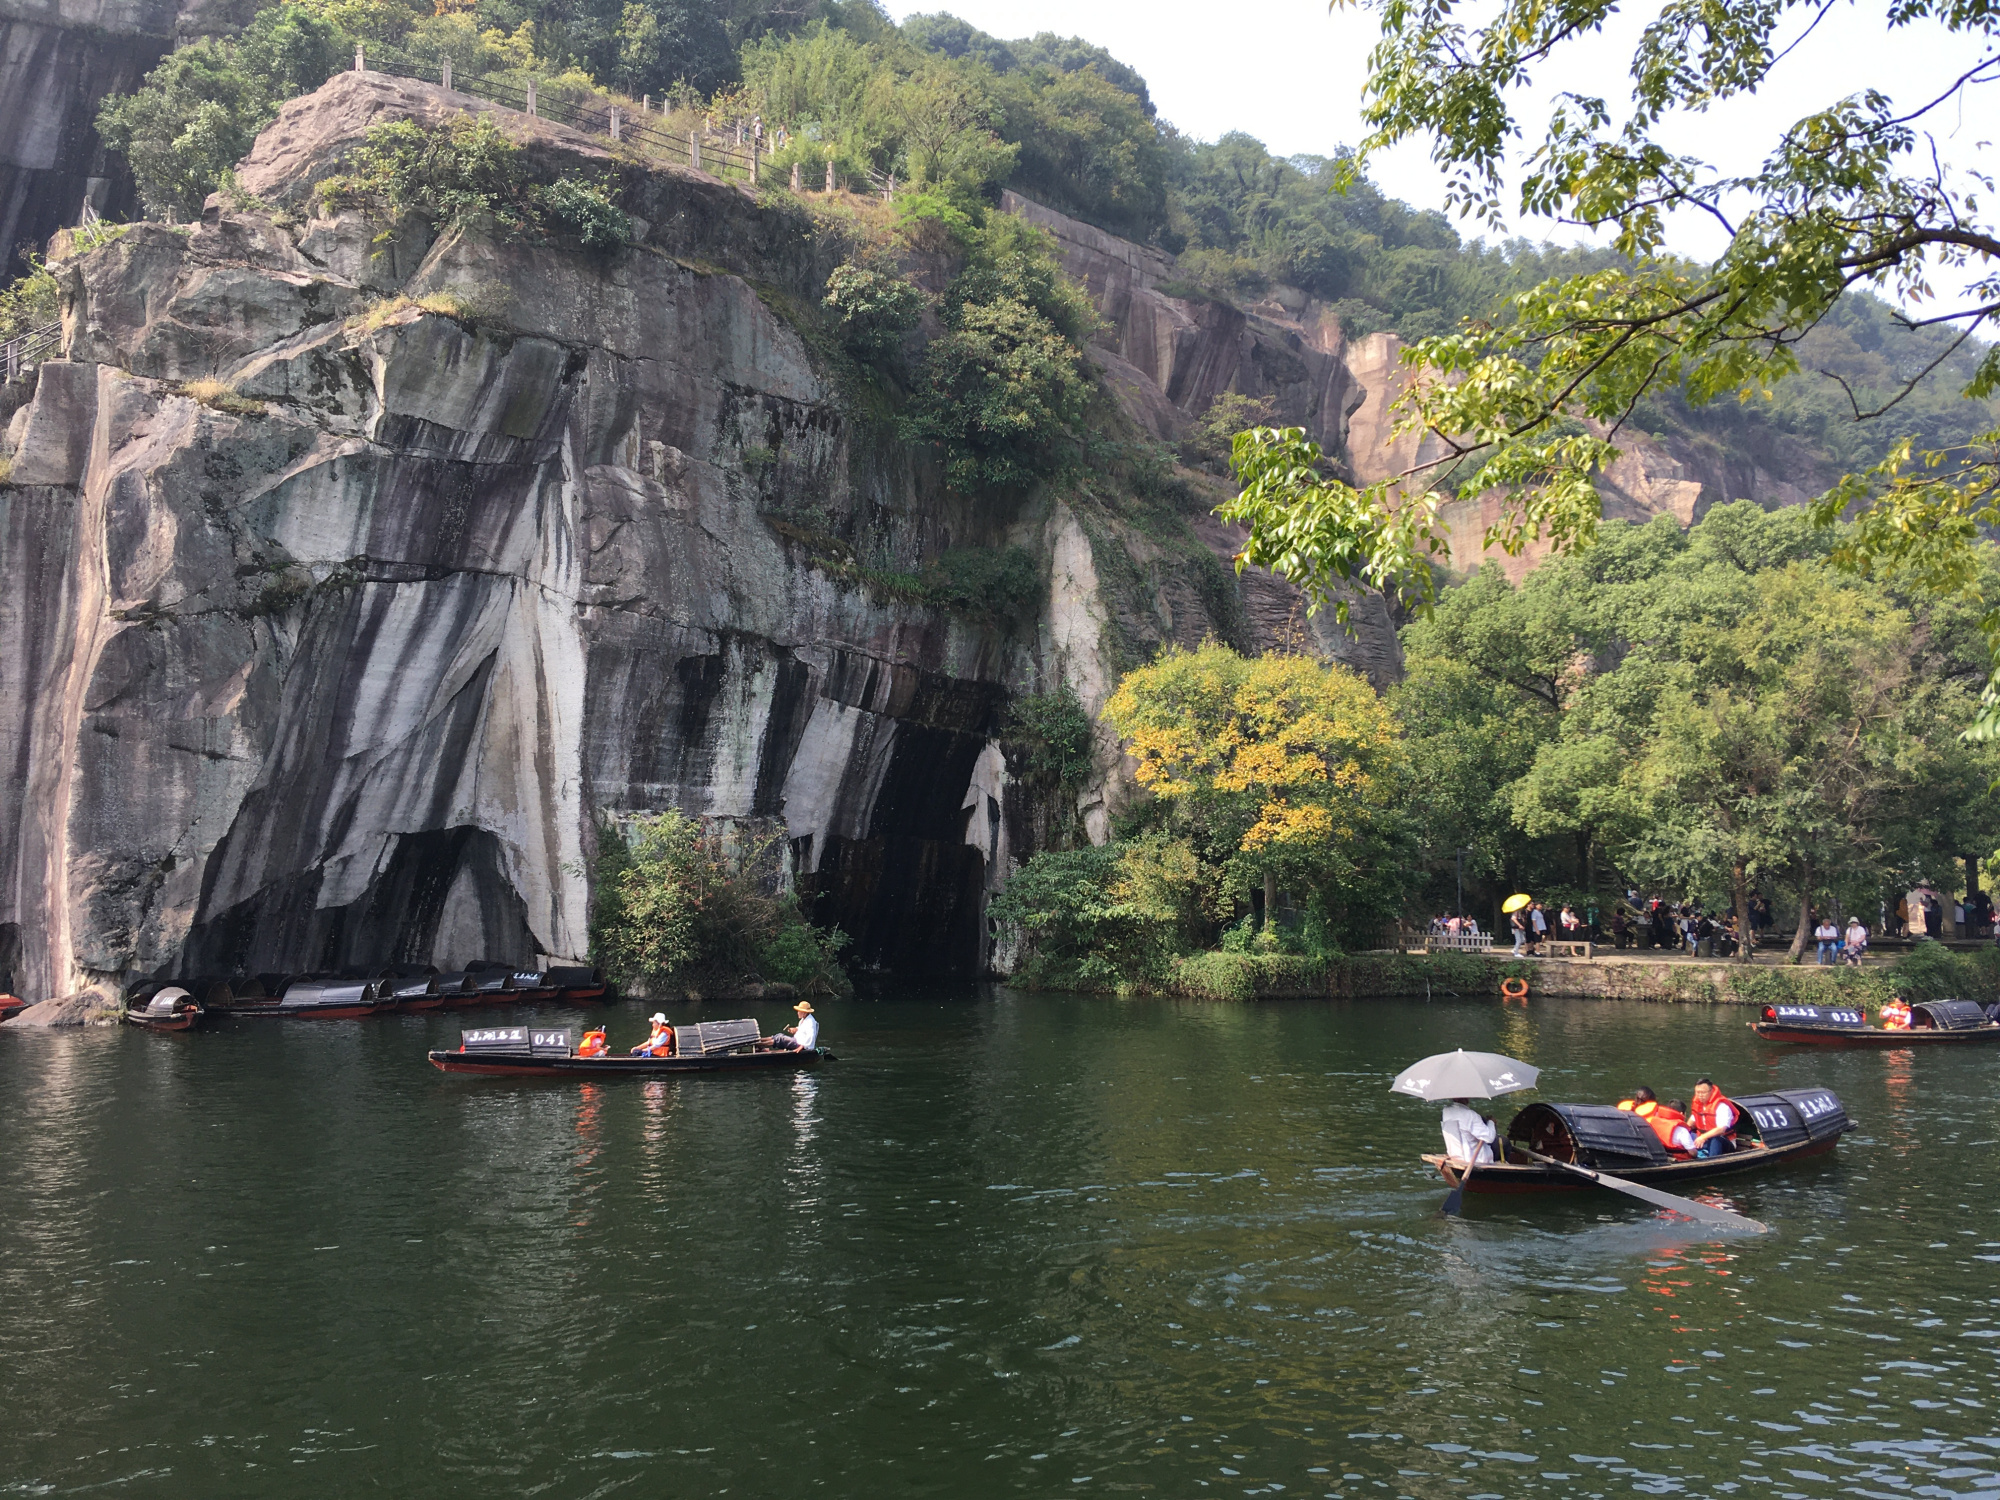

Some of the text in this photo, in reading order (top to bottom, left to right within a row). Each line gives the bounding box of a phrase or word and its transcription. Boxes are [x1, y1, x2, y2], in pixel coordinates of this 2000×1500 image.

[1831, 1012, 1859, 1023] 023
[534, 1033, 565, 1046] 041
[1754, 1108, 1788, 1129] 013
